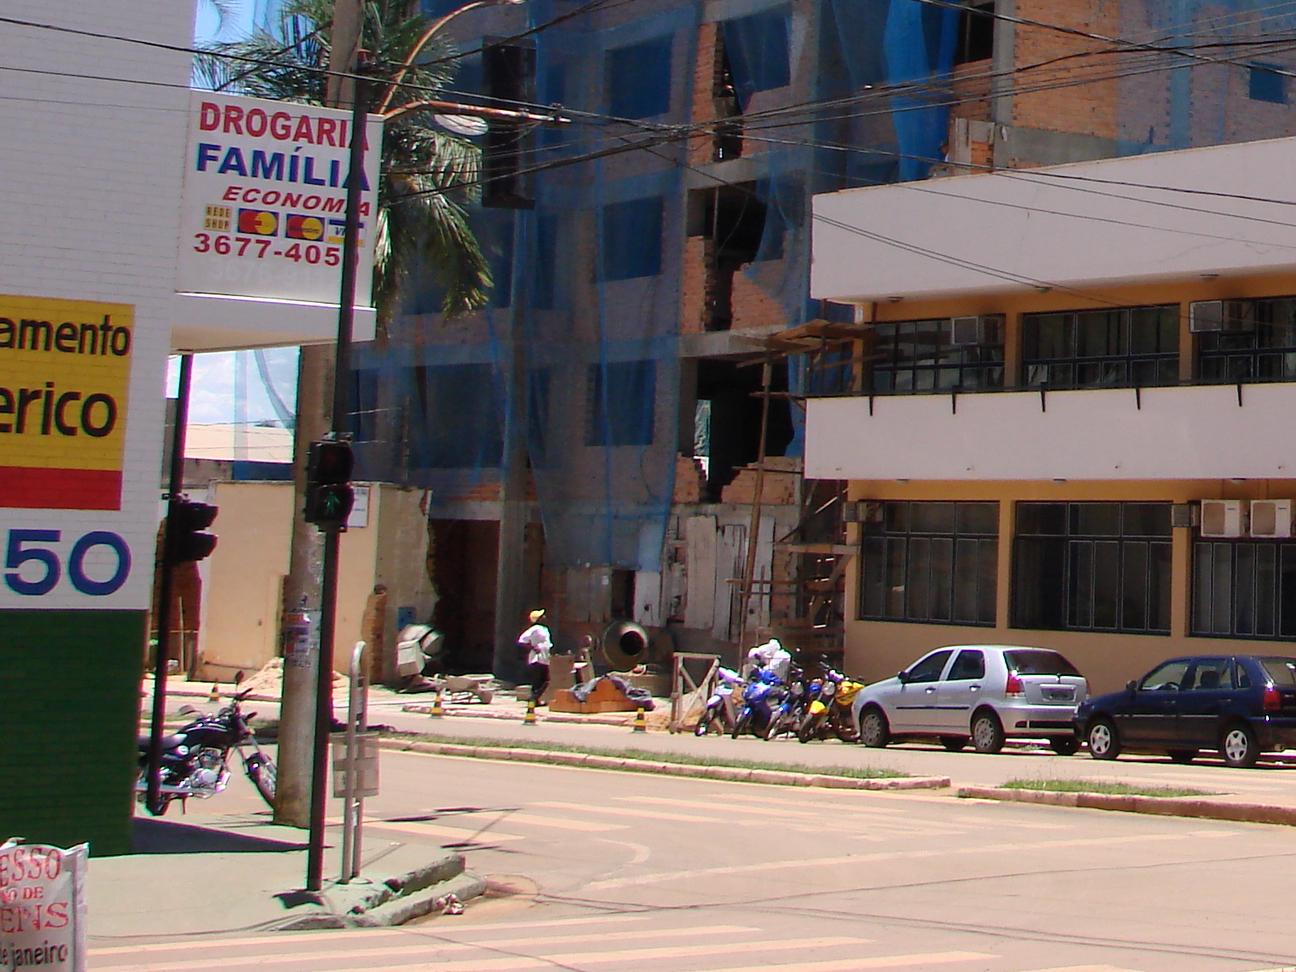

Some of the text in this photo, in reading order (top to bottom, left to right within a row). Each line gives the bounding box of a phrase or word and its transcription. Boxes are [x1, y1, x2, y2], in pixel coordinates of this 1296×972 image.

[222, 186, 371, 216] ECONOMA
[193, 233, 359, 267] 3677-405
[0, 314, 132, 356] amento
[3, 529, 133, 596] 50
[22, 886, 45, 900] DE
[11, 939, 69, 972] janeiro
